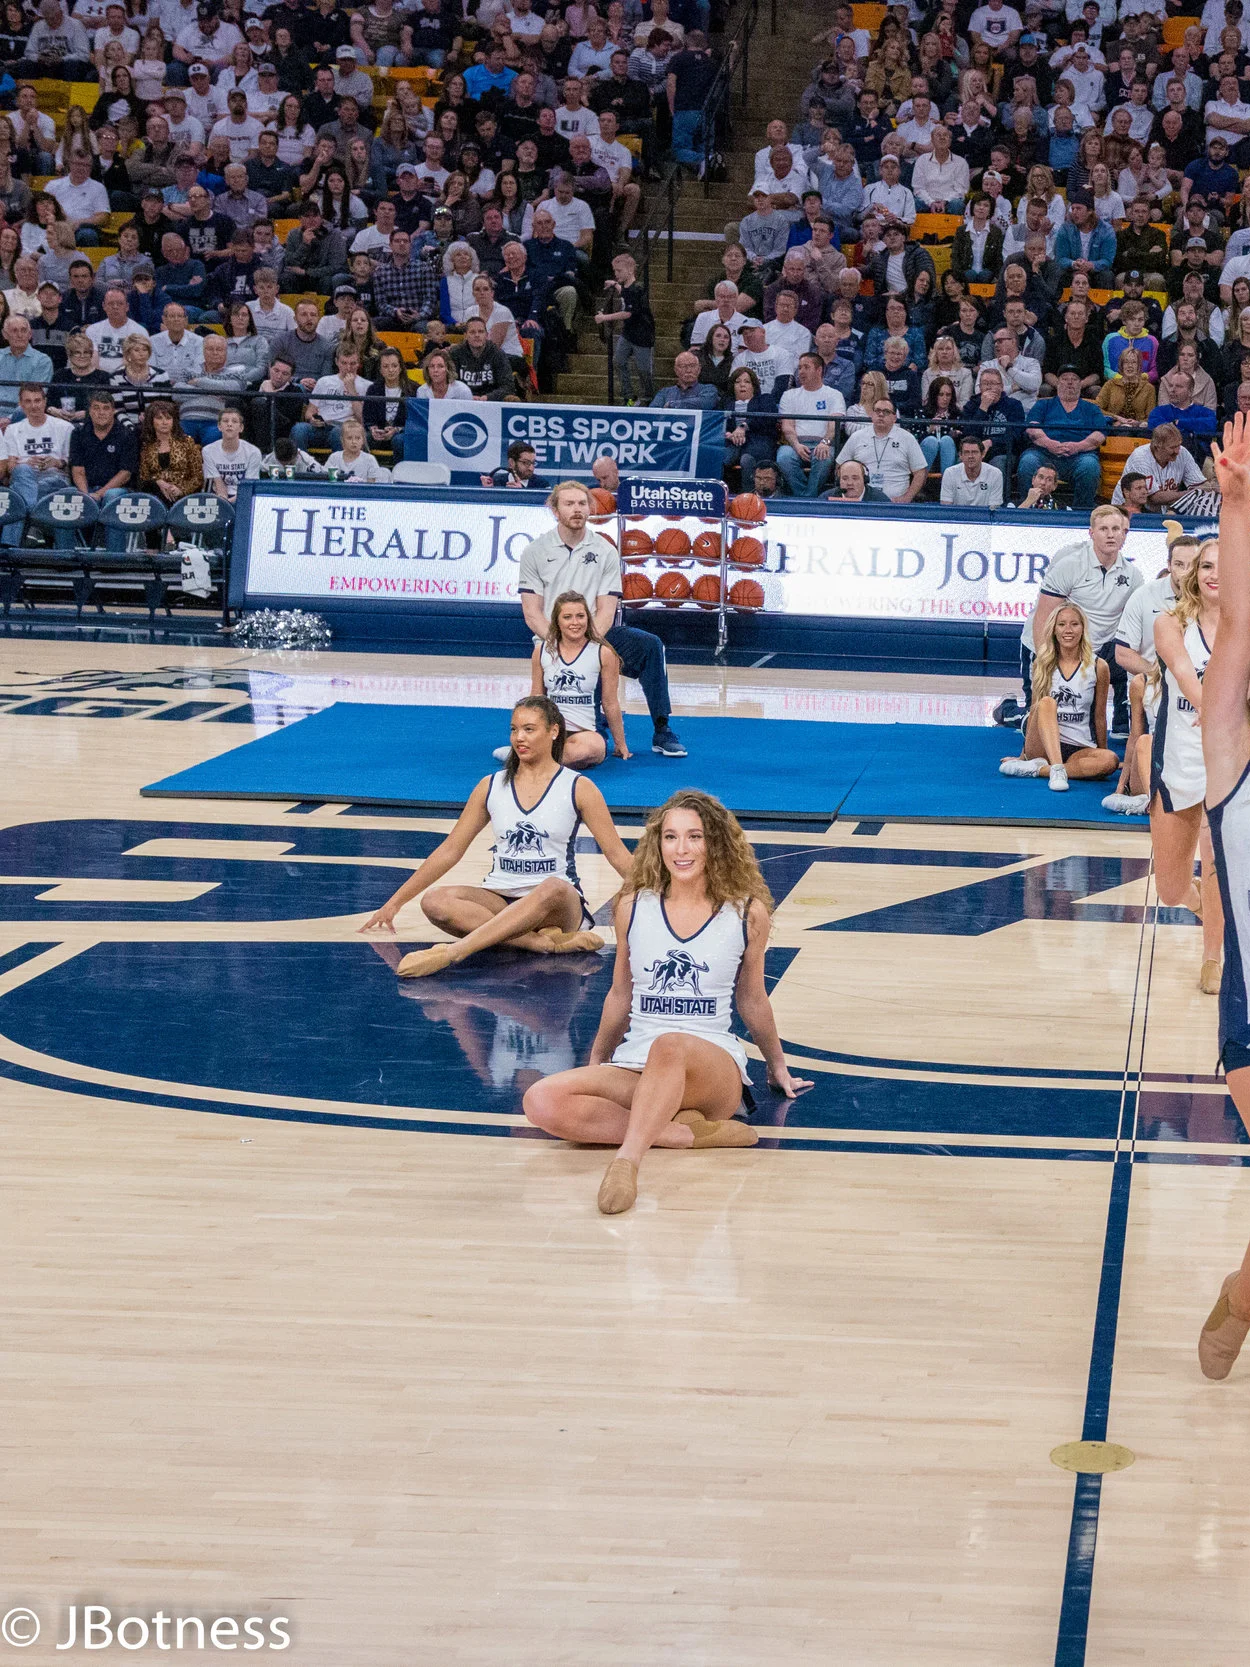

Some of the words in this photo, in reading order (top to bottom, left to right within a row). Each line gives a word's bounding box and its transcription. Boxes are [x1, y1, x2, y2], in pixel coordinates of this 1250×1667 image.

[98, 344, 121, 353] STAT
[508, 415, 565, 438] CBS
[572, 417, 688, 442] SPORTS
[24, 442, 54, 451] STATE
[508, 439, 657, 464] ETWORK
[631, 485, 713, 502] UtahState
[329, 505, 367, 520] THE
[630, 500, 714, 511] BASKETBALL
[268, 508, 472, 561] HERALD
[937, 533, 1050, 591] JOUR
[329, 575, 458, 595] EMPOWERING
[463, 580, 500, 596] THE
[919, 600, 953, 615] THE
[958, 600, 1033, 618] COMMU
[568, 695, 593, 705] STATE
[500, 856, 524, 873] UTAH
[524, 857, 557, 873] STATE
[640, 994, 674, 1014] UTAH
[674, 996, 717, 1017] STATE
